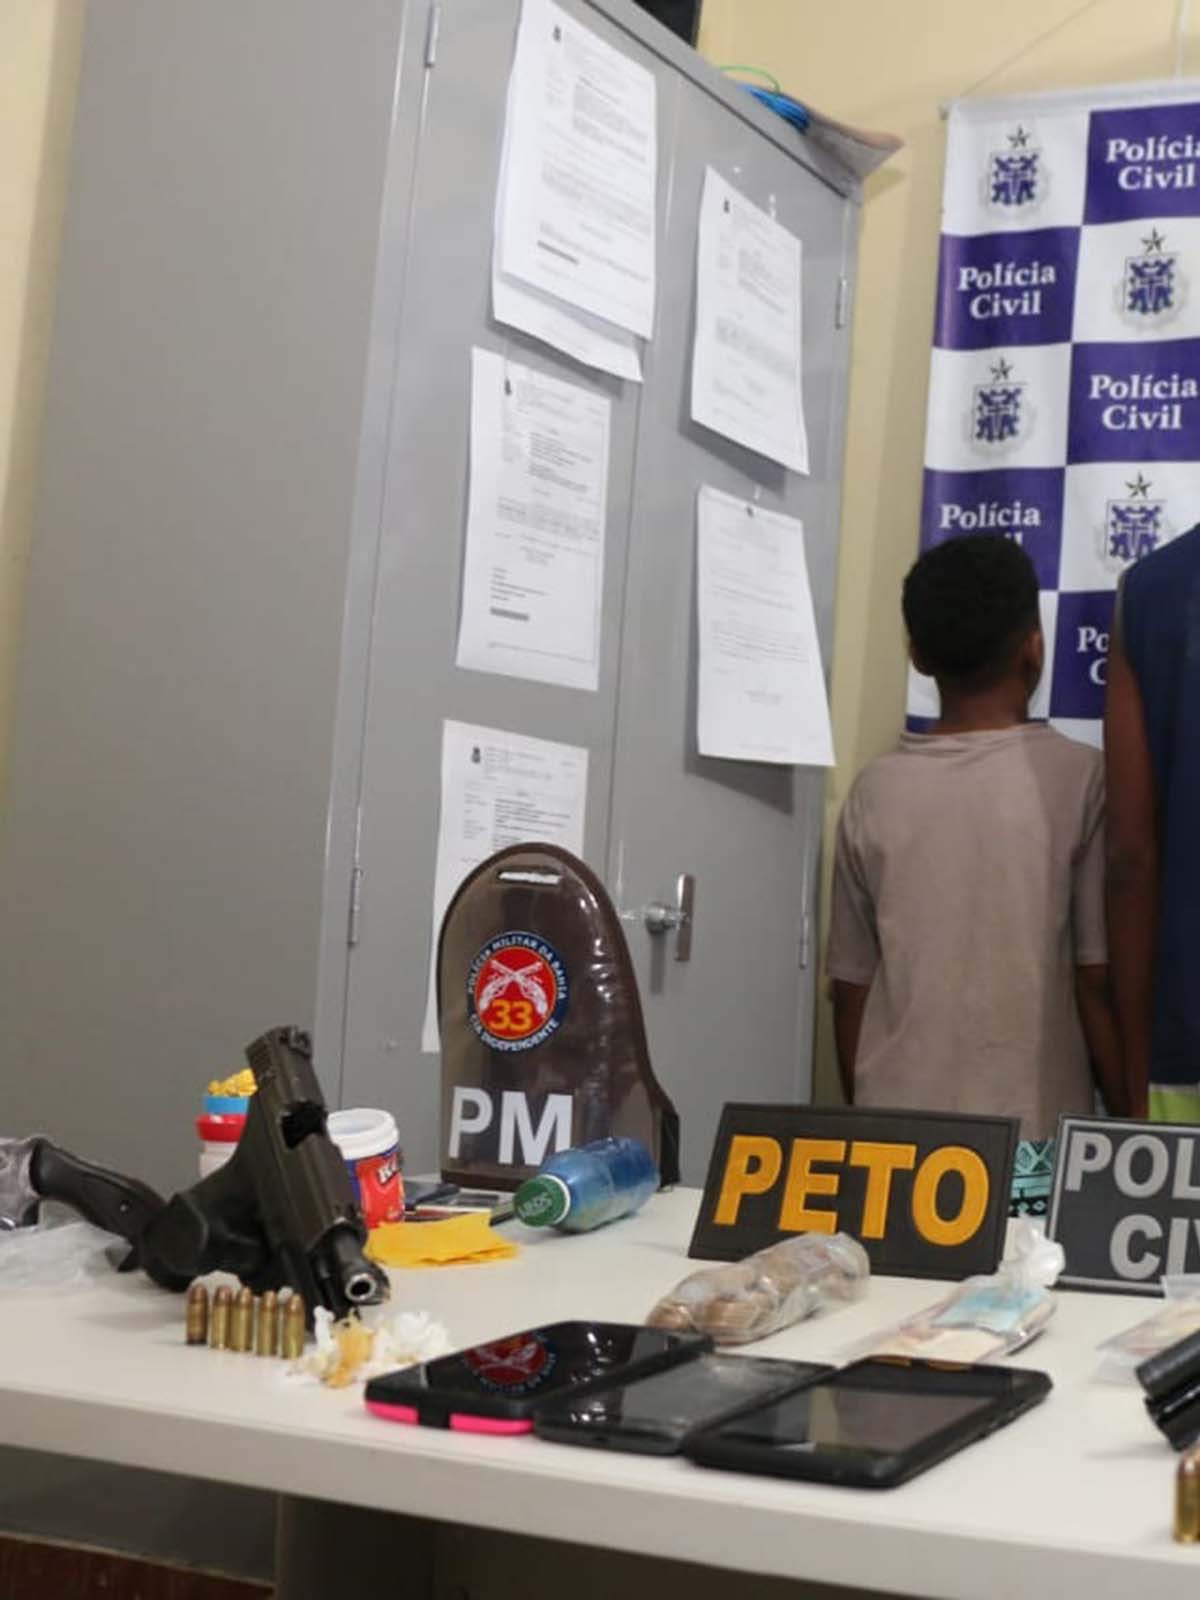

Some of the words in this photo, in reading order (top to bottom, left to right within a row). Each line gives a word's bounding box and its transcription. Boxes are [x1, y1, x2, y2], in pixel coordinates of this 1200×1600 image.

[1118, 162, 1196, 190] Civil
[957, 261, 1056, 291] Polícia
[970, 291, 1041, 319] Civil
[1088, 373, 1198, 400] Polícia
[1101, 404, 1182, 431] Civil
[940, 501, 1041, 530] Polícia
[489, 999, 534, 1031] 33
[448, 1086, 574, 1167] PM
[713, 1134, 990, 1247] PETO
